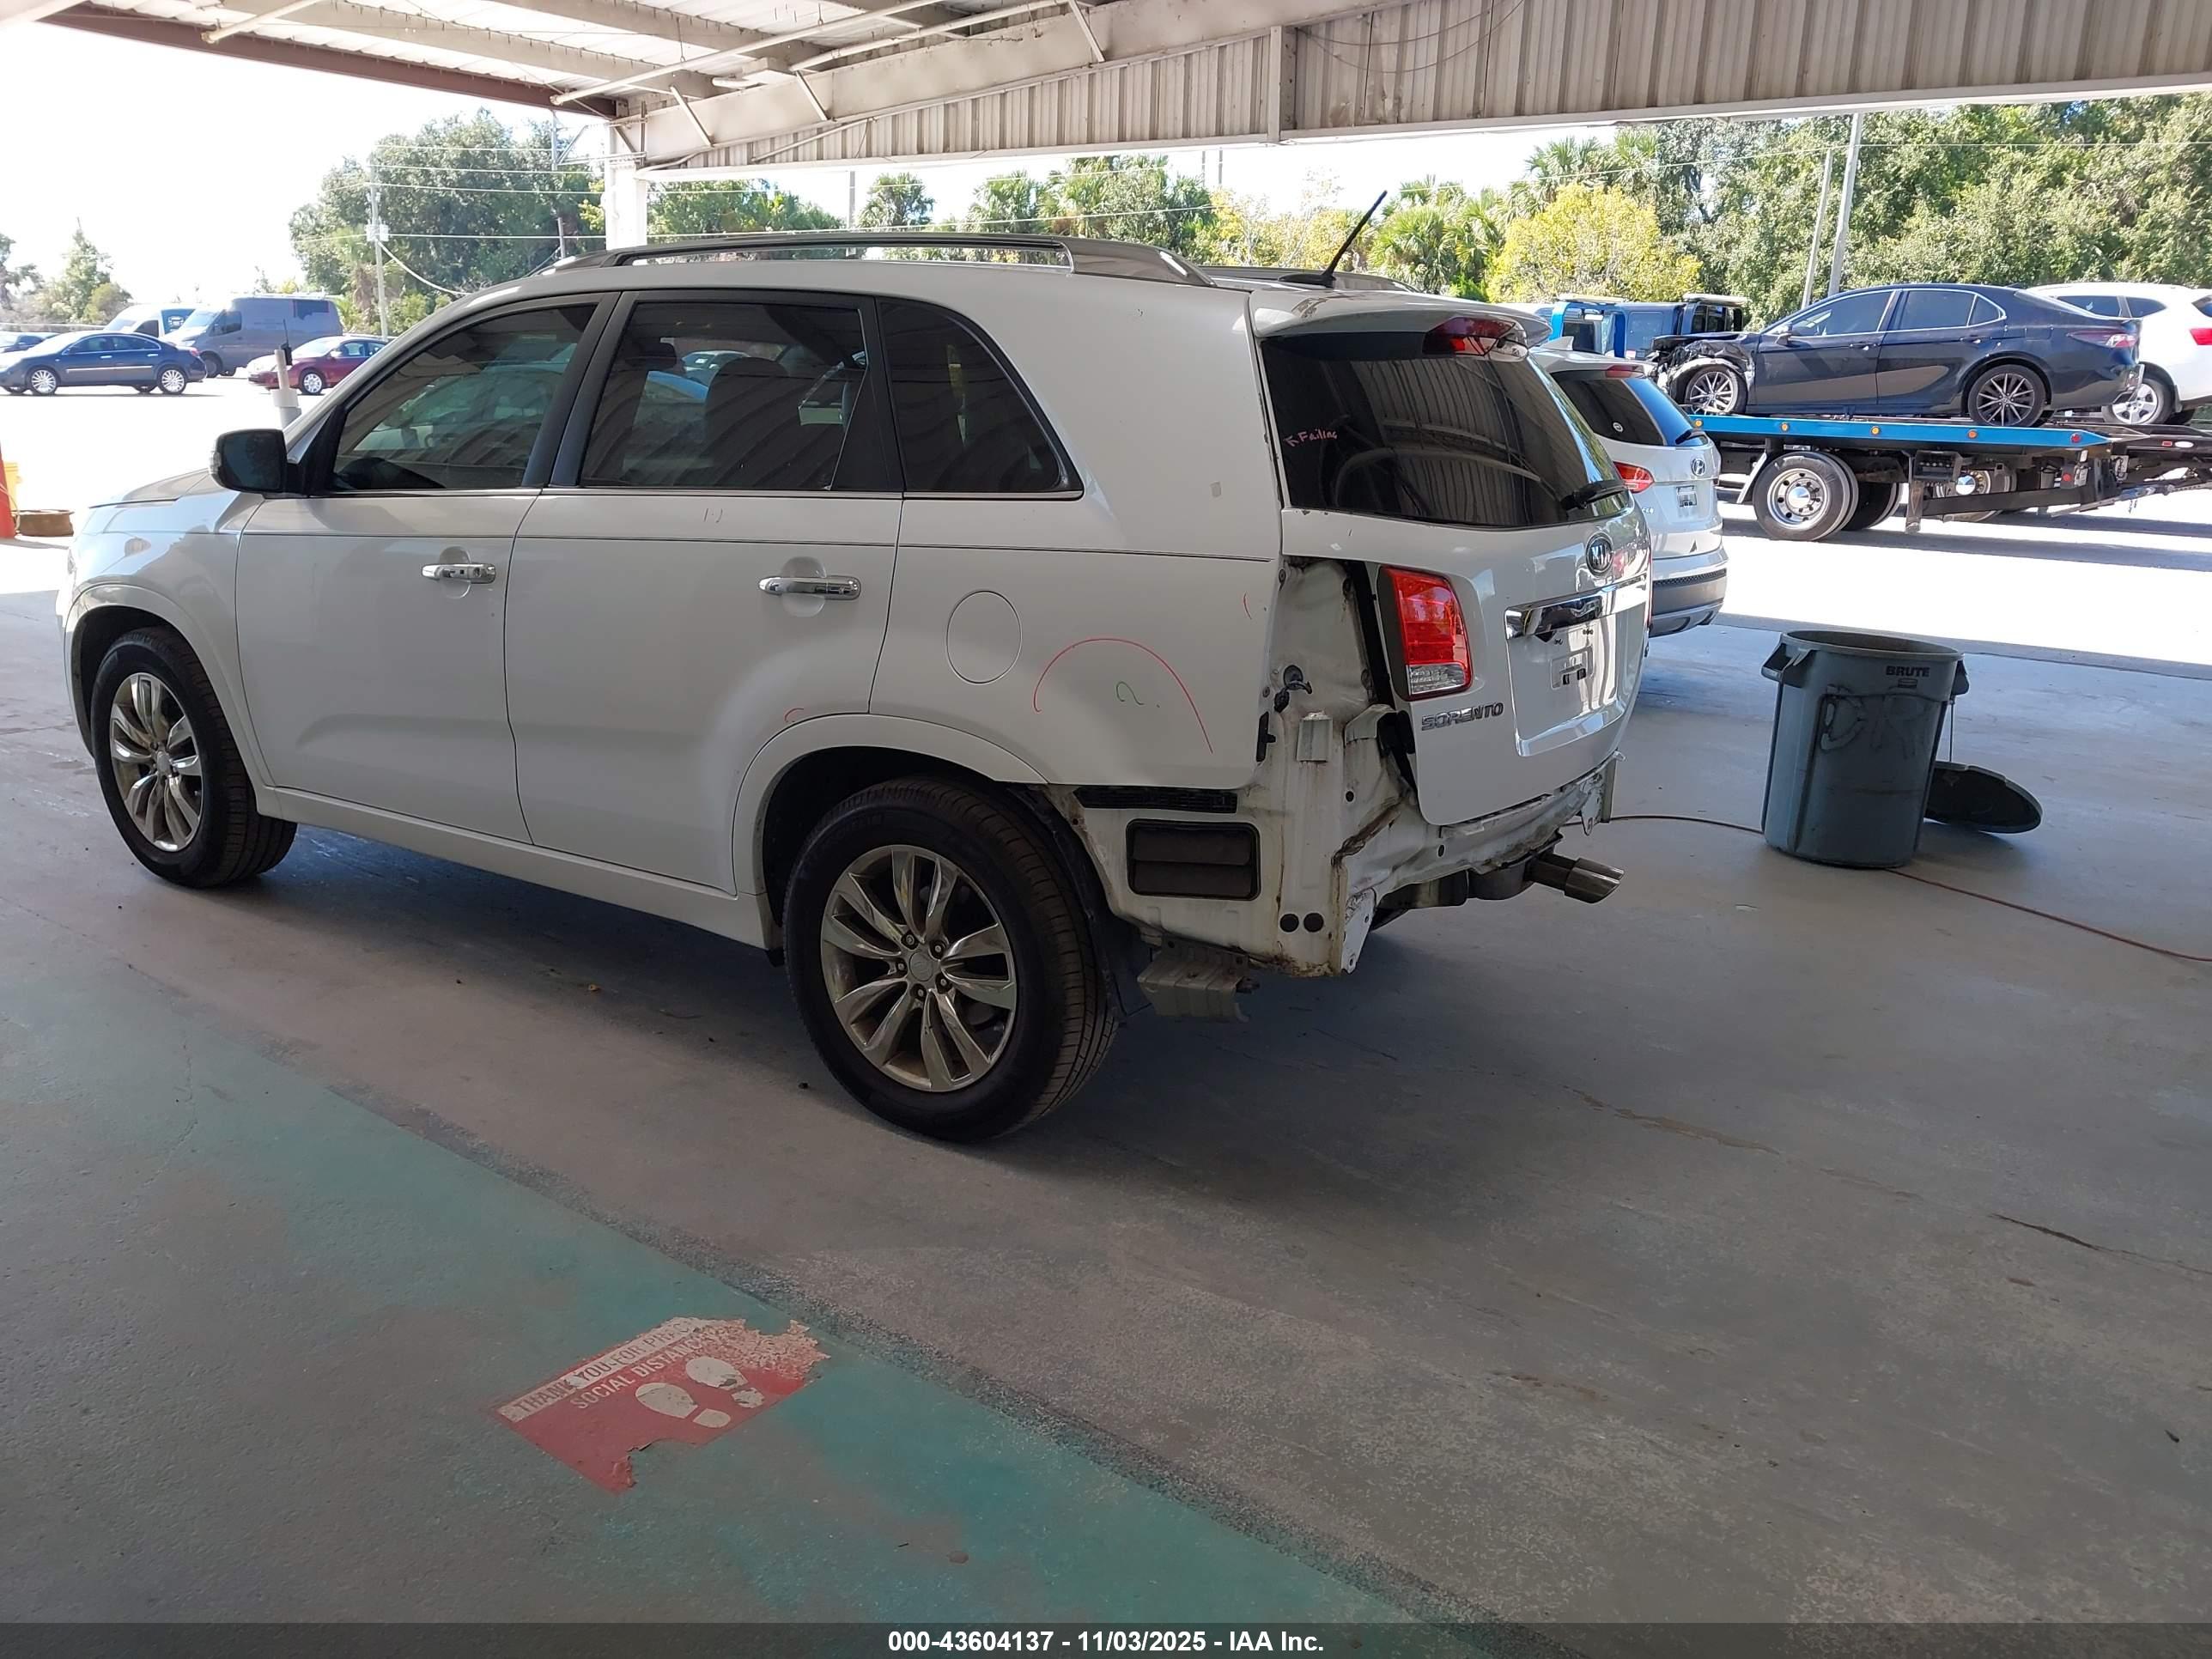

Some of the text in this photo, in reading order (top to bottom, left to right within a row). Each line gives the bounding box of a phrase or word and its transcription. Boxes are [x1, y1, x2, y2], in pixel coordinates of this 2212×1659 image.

[1886, 665, 1930, 678] BRUTE
[1422, 702, 1504, 731] SORENTO
[514, 1379, 575, 1413] THANK
[574, 1361, 612, 1382] YOU
[569, 1375, 635, 1409] SOCIAL
